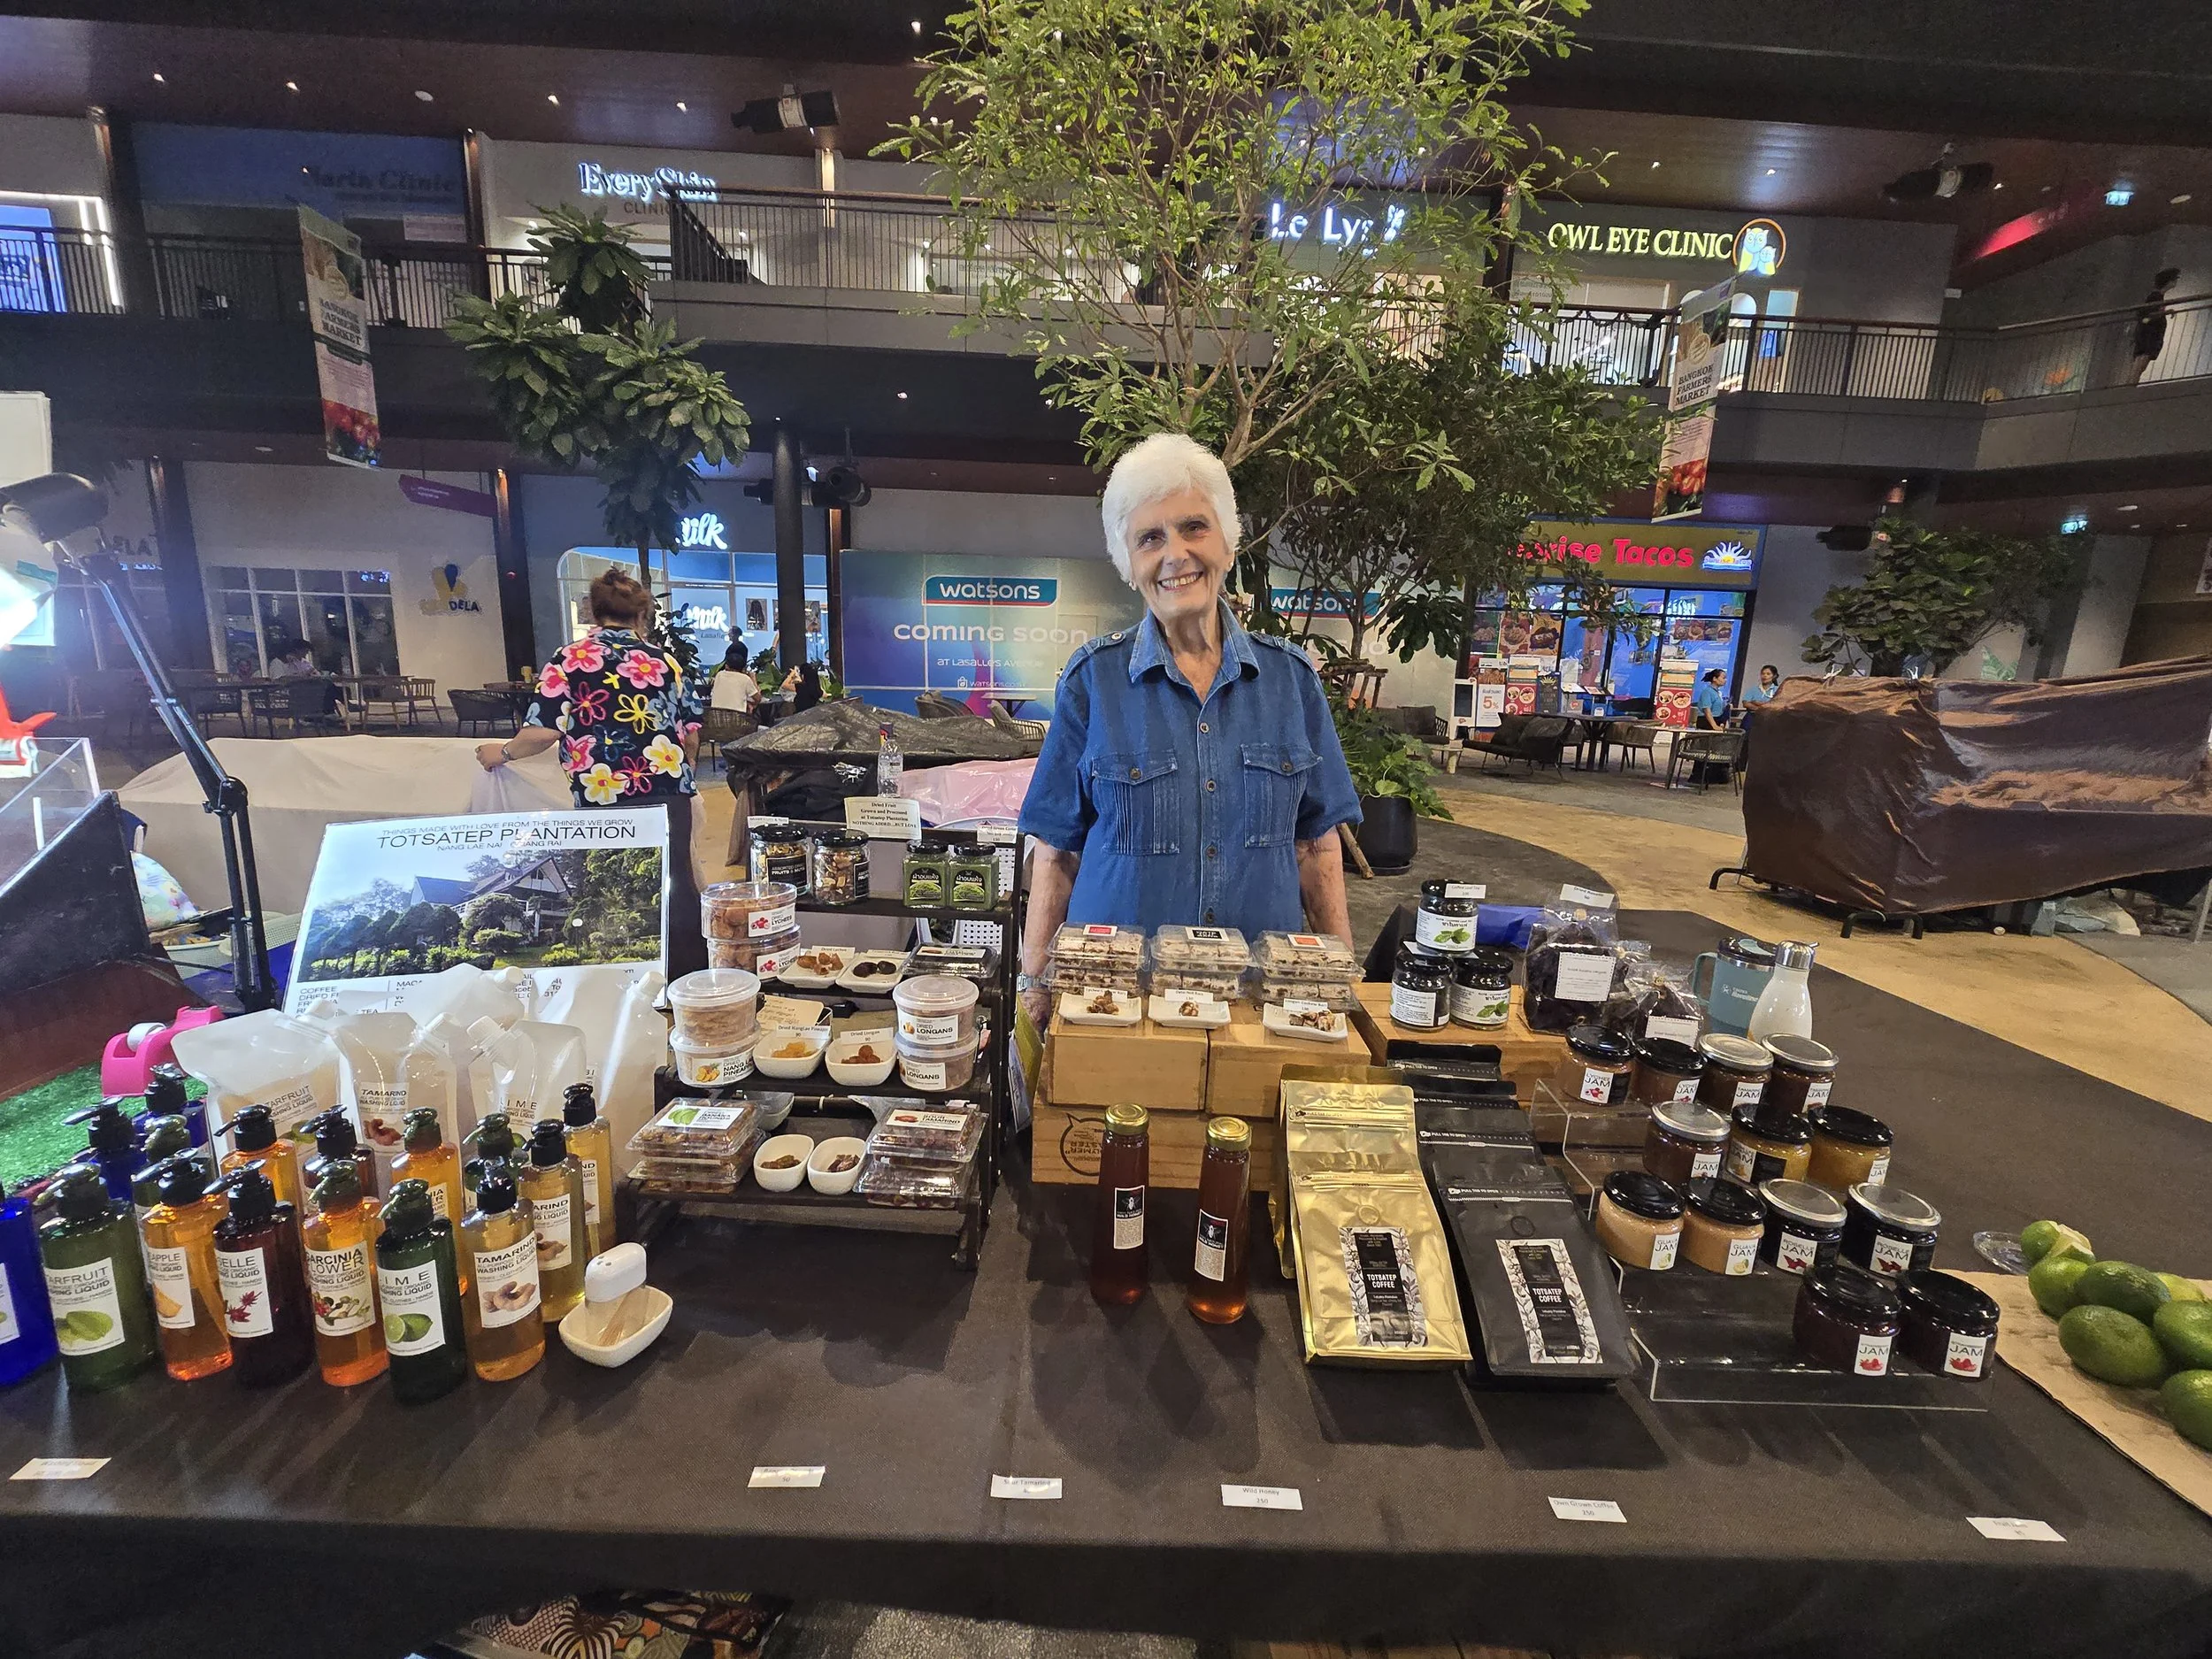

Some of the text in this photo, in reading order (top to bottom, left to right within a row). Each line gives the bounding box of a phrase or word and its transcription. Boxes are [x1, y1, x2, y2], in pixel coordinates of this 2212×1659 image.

[1548, 222, 1733, 259] OWL EYE CLINIC
[1678, 364, 1714, 385] BANGKOK
[1676, 375, 1712, 396] FARMERS
[1674, 385, 1710, 406] MARKET
[1613, 538, 1694, 567] Tacos
[940, 582, 1041, 600] watsons
[1013, 626, 1088, 644] soon
[1483, 695, 1499, 710] 5%
[377, 826, 635, 849] TOTSATEP PLANTATION
[382, 827, 417, 836] THINGS
[772, 915, 793, 926] LYCHEES
[300, 986, 338, 995] COFFEE
[724, 1062, 744, 1072] NANG
[906, 1071, 940, 1080] LONGANS
[1584, 1076, 1610, 1087] JAM
[361, 1088, 407, 1097] TAMARIND
[1676, 1086, 1696, 1094] JAM
[1736, 1090, 1761, 1099] JAM
[1808, 1090, 1829, 1099] JAM
[292, 1096, 313, 1110] LIQUID
[1694, 1163, 1718, 1171] JAM
[543, 1210, 568, 1220] LIQUID
[476, 1236, 535, 1263] TAMARIND
[1655, 1242, 1678, 1252] JAM
[1783, 1238, 1815, 1250] ROSELLE
[1877, 1240, 1910, 1254] ROSELLE
[1731, 1248, 1756, 1256] JAM
[1781, 1244, 1814, 1257] JAM
[1875, 1246, 1909, 1261] JAM
[476, 1247, 536, 1274] WASHING LIQUID
[232, 1270, 260, 1279] LIQUID
[336, 1270, 365, 1283] LIQUID
[75, 1279, 110, 1294] LIQUID
[404, 1282, 432, 1295] LIQUID
[1859, 1347, 1888, 1356] JAM
[1949, 1345, 1983, 1356] JAM
